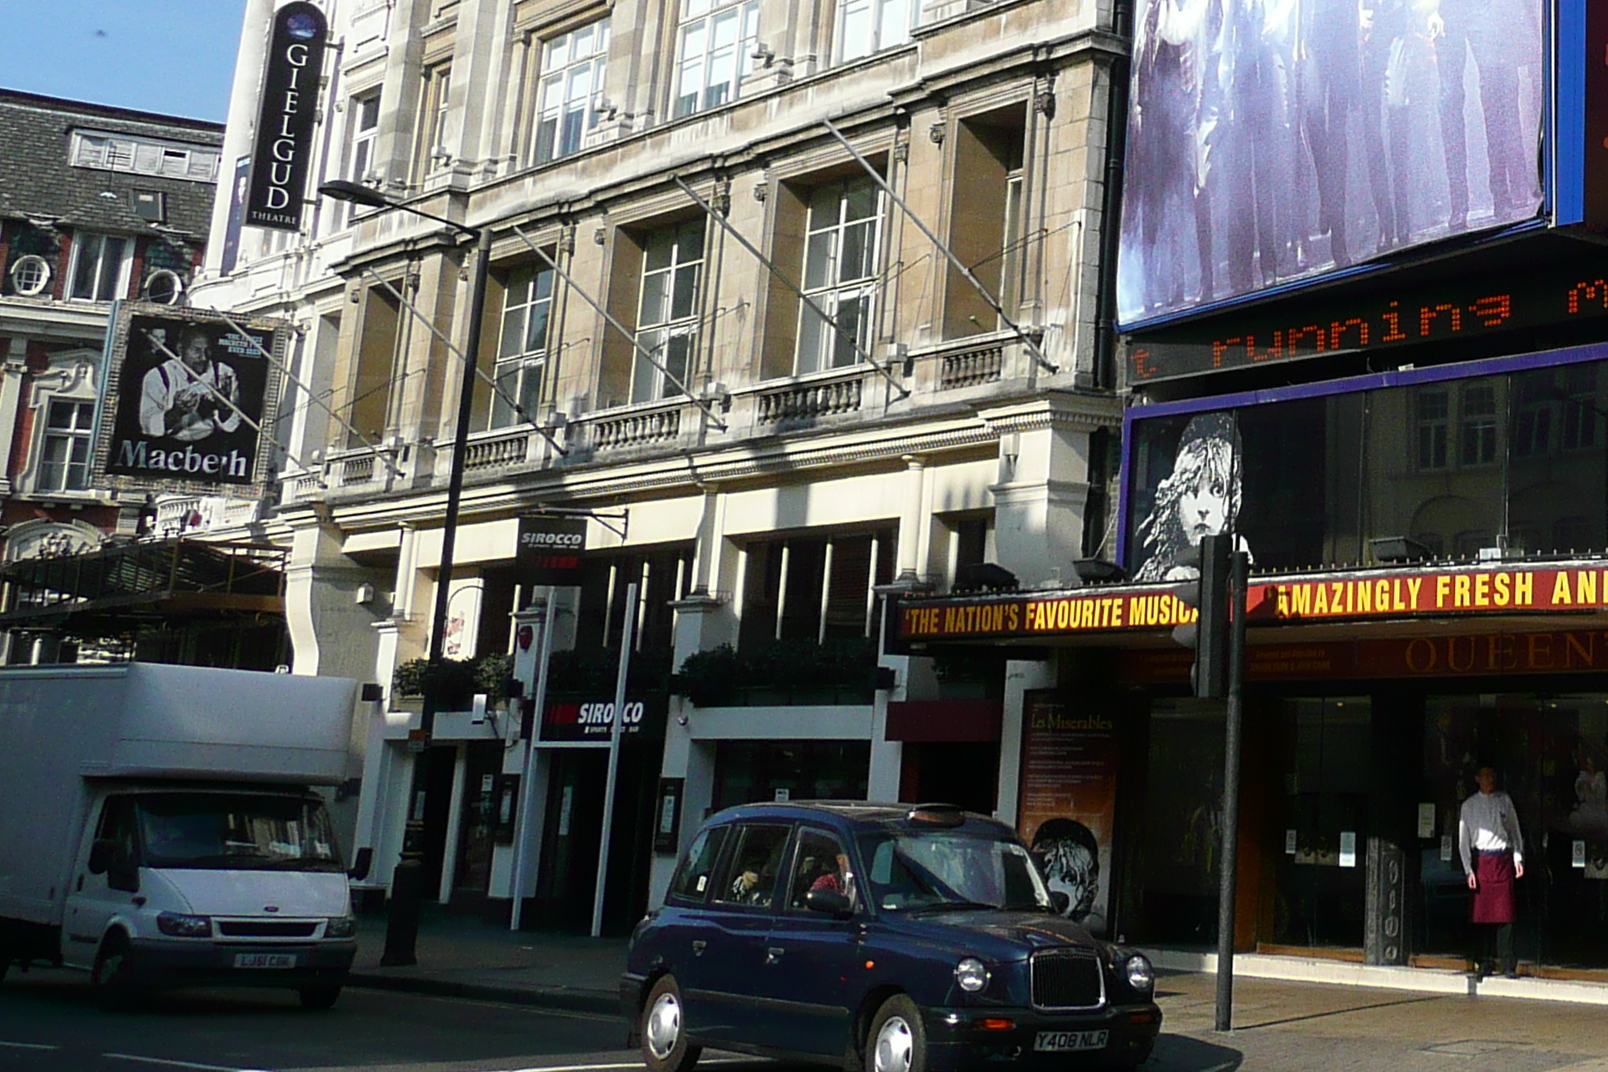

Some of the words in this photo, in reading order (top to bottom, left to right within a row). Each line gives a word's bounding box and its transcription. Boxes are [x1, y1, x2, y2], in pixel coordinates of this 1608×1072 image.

[266, 43, 308, 210] GIELGUD
[251, 210, 297, 226] THEATRE
[1212, 293, 1511, 368] running
[521, 532, 582, 545] SIROCCO
[1436, 571, 1533, 609] FRESH
[944, 604, 1019, 633] NATION'S
[1025, 596, 1122, 630] FAVOURITE
[578, 702, 644, 724] SIROCO
[1038, 1032, 1078, 1049] Y408
[1080, 1031, 1108, 1048] NLR
